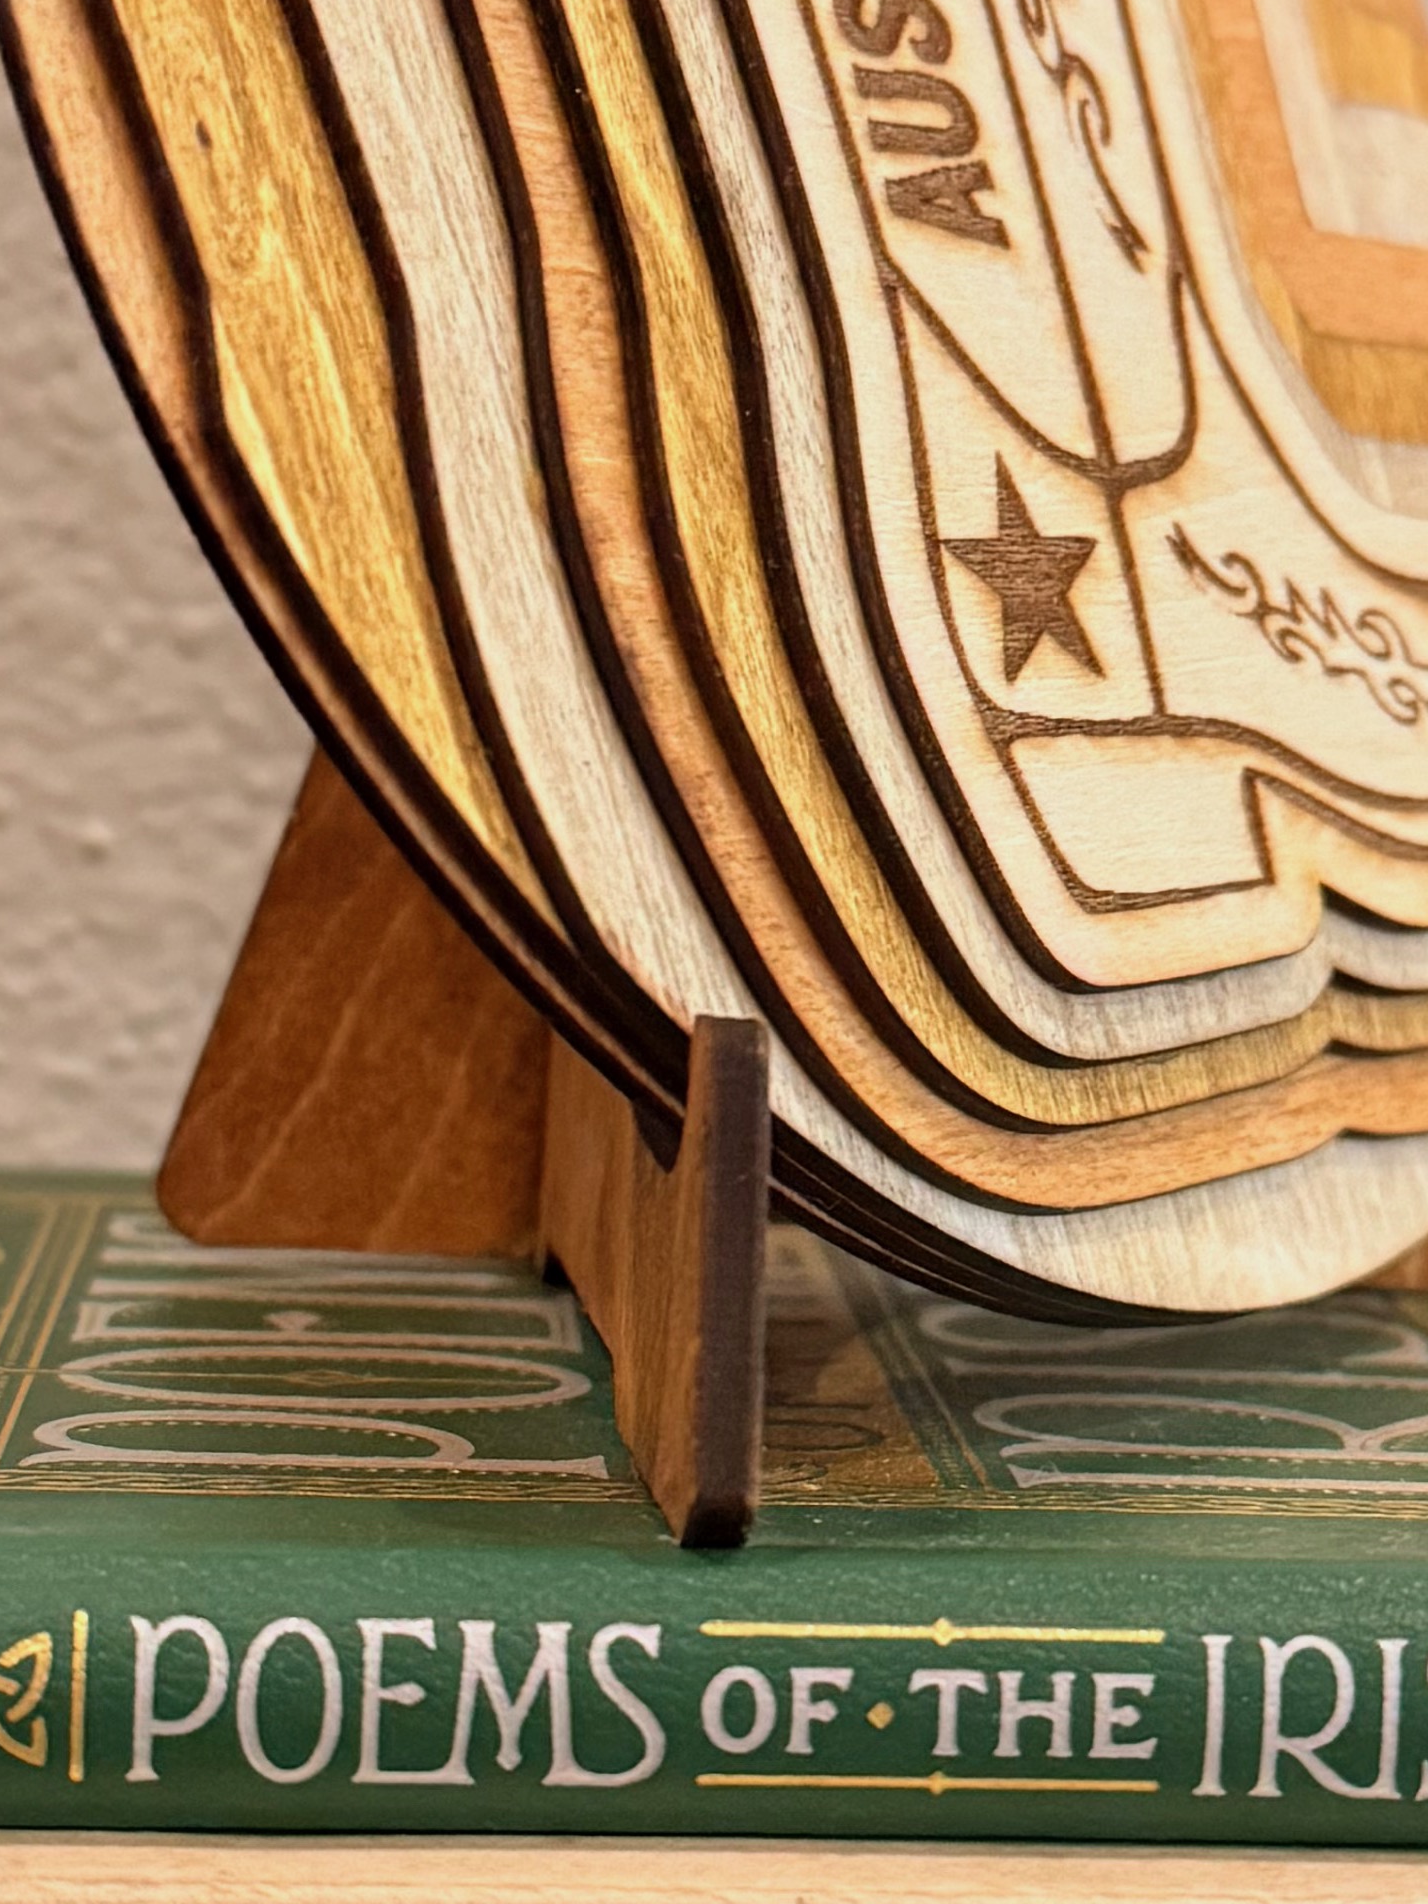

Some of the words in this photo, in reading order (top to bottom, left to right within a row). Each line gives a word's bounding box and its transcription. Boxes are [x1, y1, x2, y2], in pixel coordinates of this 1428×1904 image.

[18, 1212, 608, 1480] POEM
[124, 1614, 667, 1788] POEMS
[700, 1664, 854, 1758] OF
[904, 1668, 1159, 1760] THE
